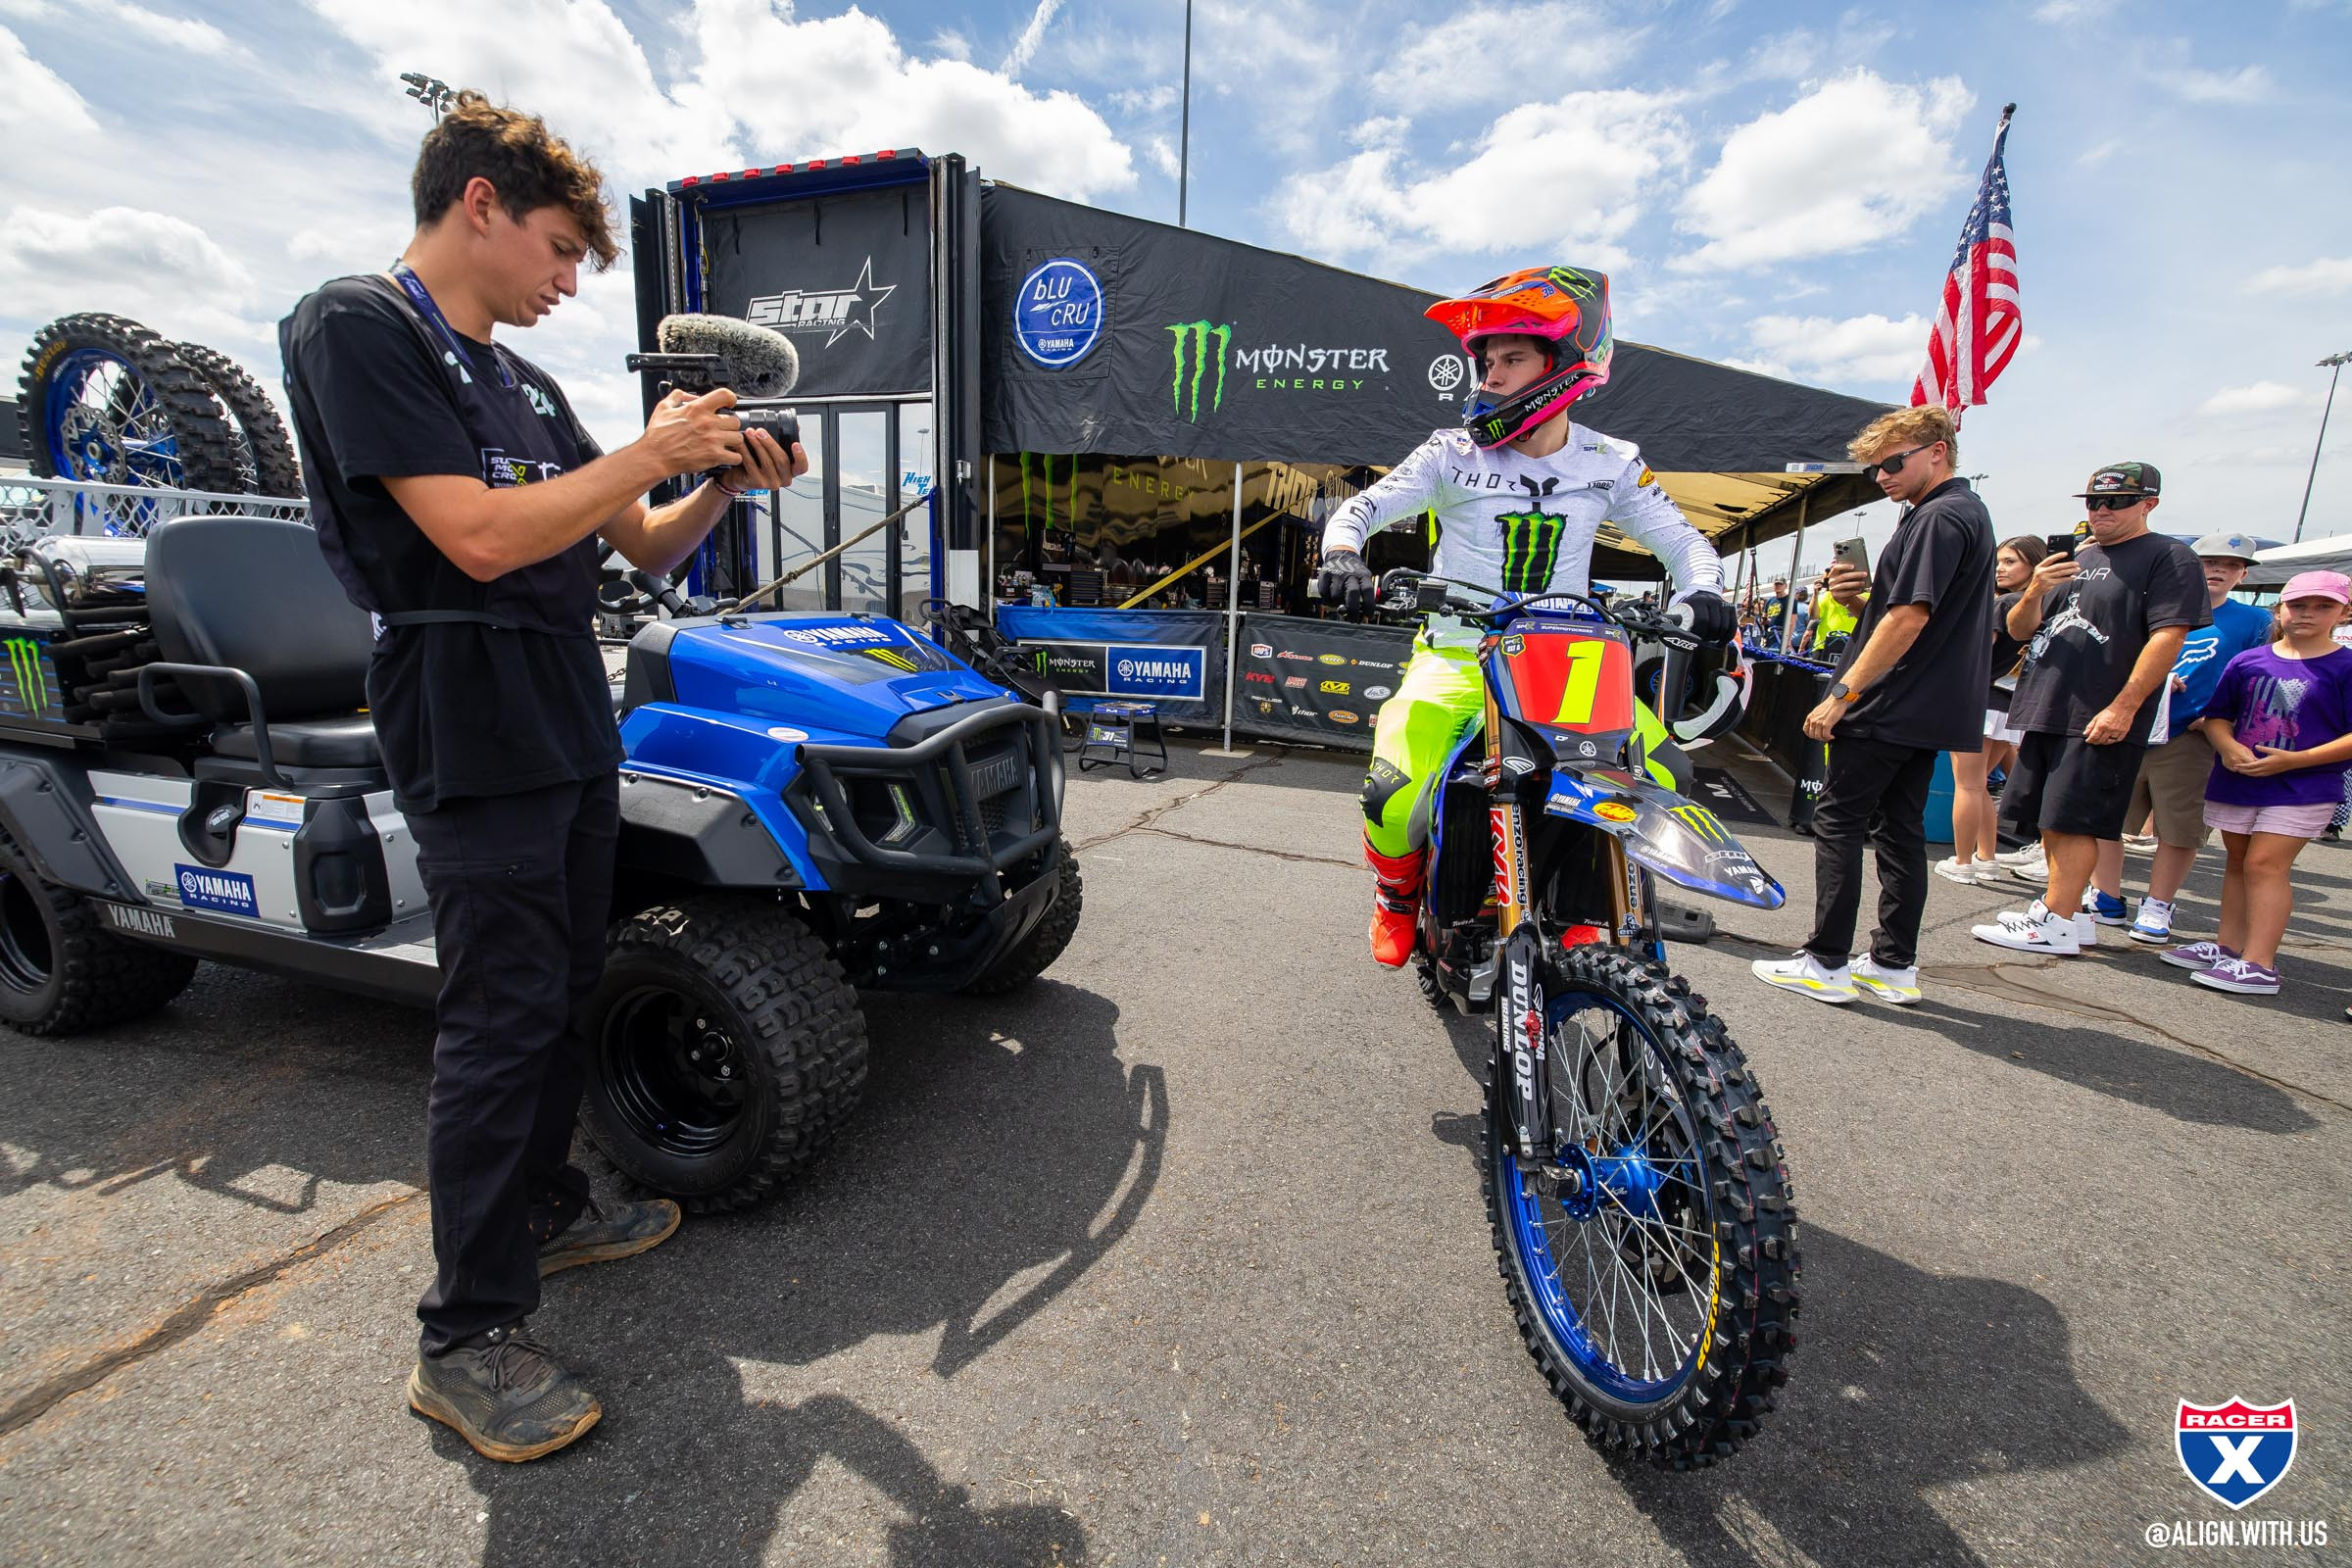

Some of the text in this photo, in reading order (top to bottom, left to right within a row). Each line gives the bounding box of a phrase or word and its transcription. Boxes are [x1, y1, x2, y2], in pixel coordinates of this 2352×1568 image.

[798, 318, 846, 328] RACING
[1047, 338, 1075, 348] YAMAHA
[1255, 377, 1365, 391] ENERGY
[902, 471, 932, 487] HIGH
[1113, 466, 1194, 504] ENERGY
[916, 482, 930, 496] TE
[802, 626, 890, 642] YAMAHA
[814, 636, 893, 648] RACING
[1134, 661, 1192, 679] YAMAHA
[1358, 660, 1394, 669] DUNLOP
[1549, 640, 1607, 725] 1
[1557, 794, 1582, 808] YAMAHA
[1724, 864, 1760, 877] YAMAH
[195, 874, 252, 902] YAMAHA
[189, 893, 250, 908] RACING
[107, 903, 176, 939] YAMAHA
[1500, 996, 1512, 1054] BRAKING
[1510, 959, 1534, 1102] DUNLOP
